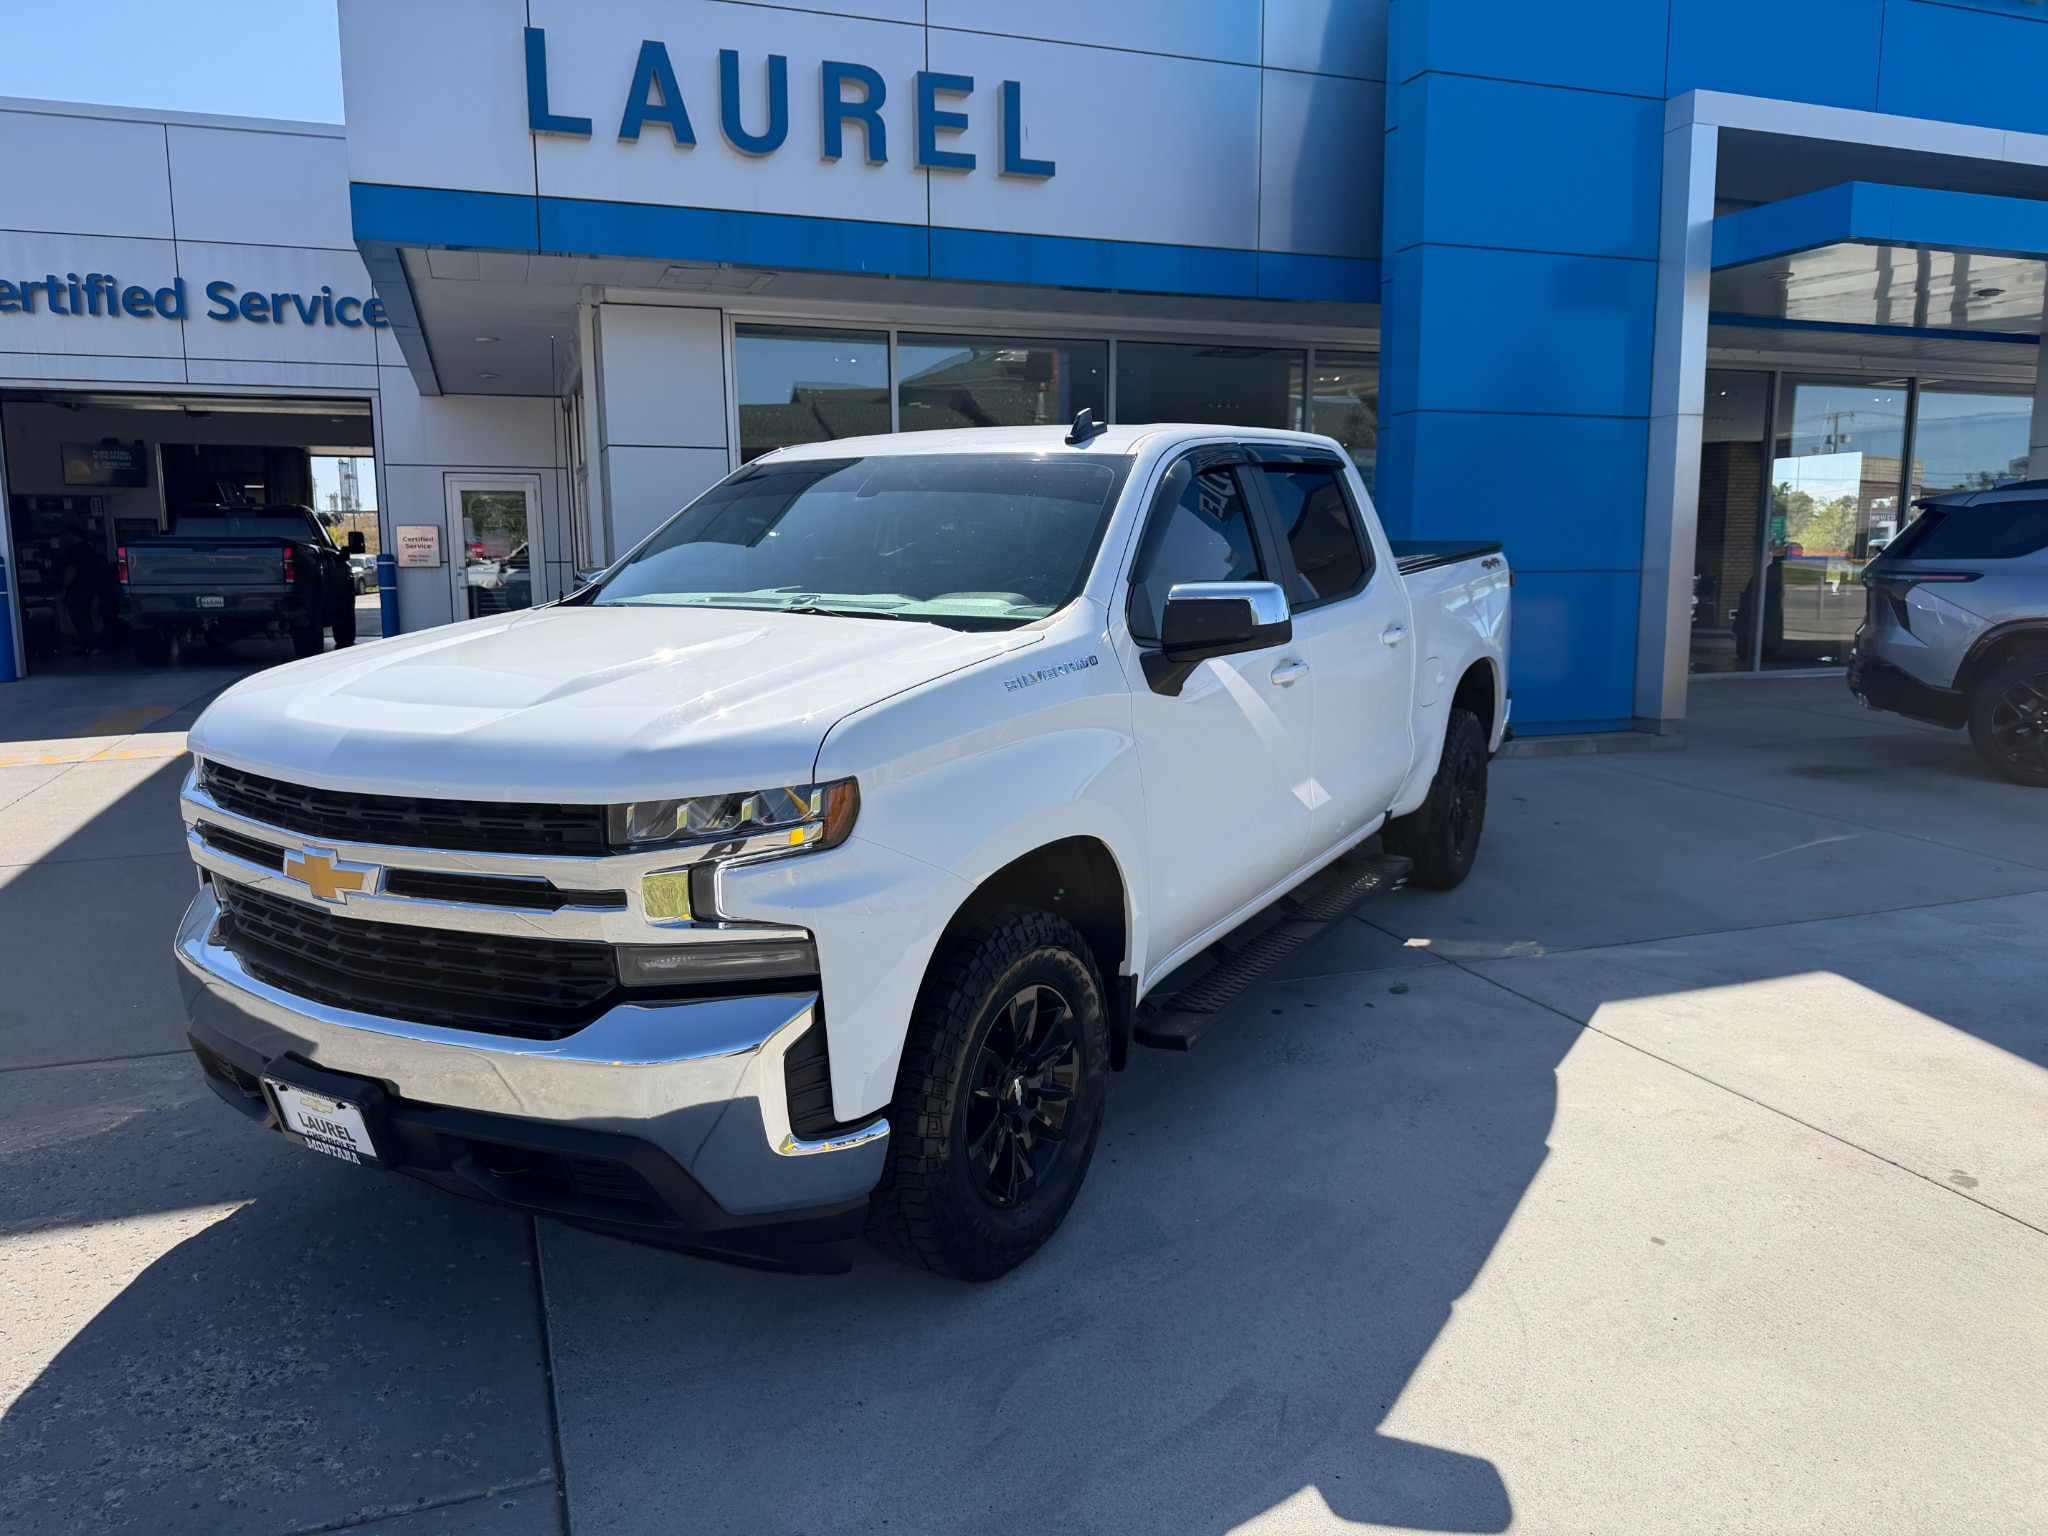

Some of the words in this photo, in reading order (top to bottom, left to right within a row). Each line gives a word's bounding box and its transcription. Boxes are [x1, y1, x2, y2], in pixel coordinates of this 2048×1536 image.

[524, 27, 1056, 182] LAUREL
[0, 273, 188, 320] ertified
[206, 281, 390, 328] Service
[1004, 655, 1099, 692] SILVERADO
[297, 1111, 357, 1143] LAUREL
[306, 1129, 357, 1152] CHEVROLET
[304, 1138, 361, 1165] MONTANA
